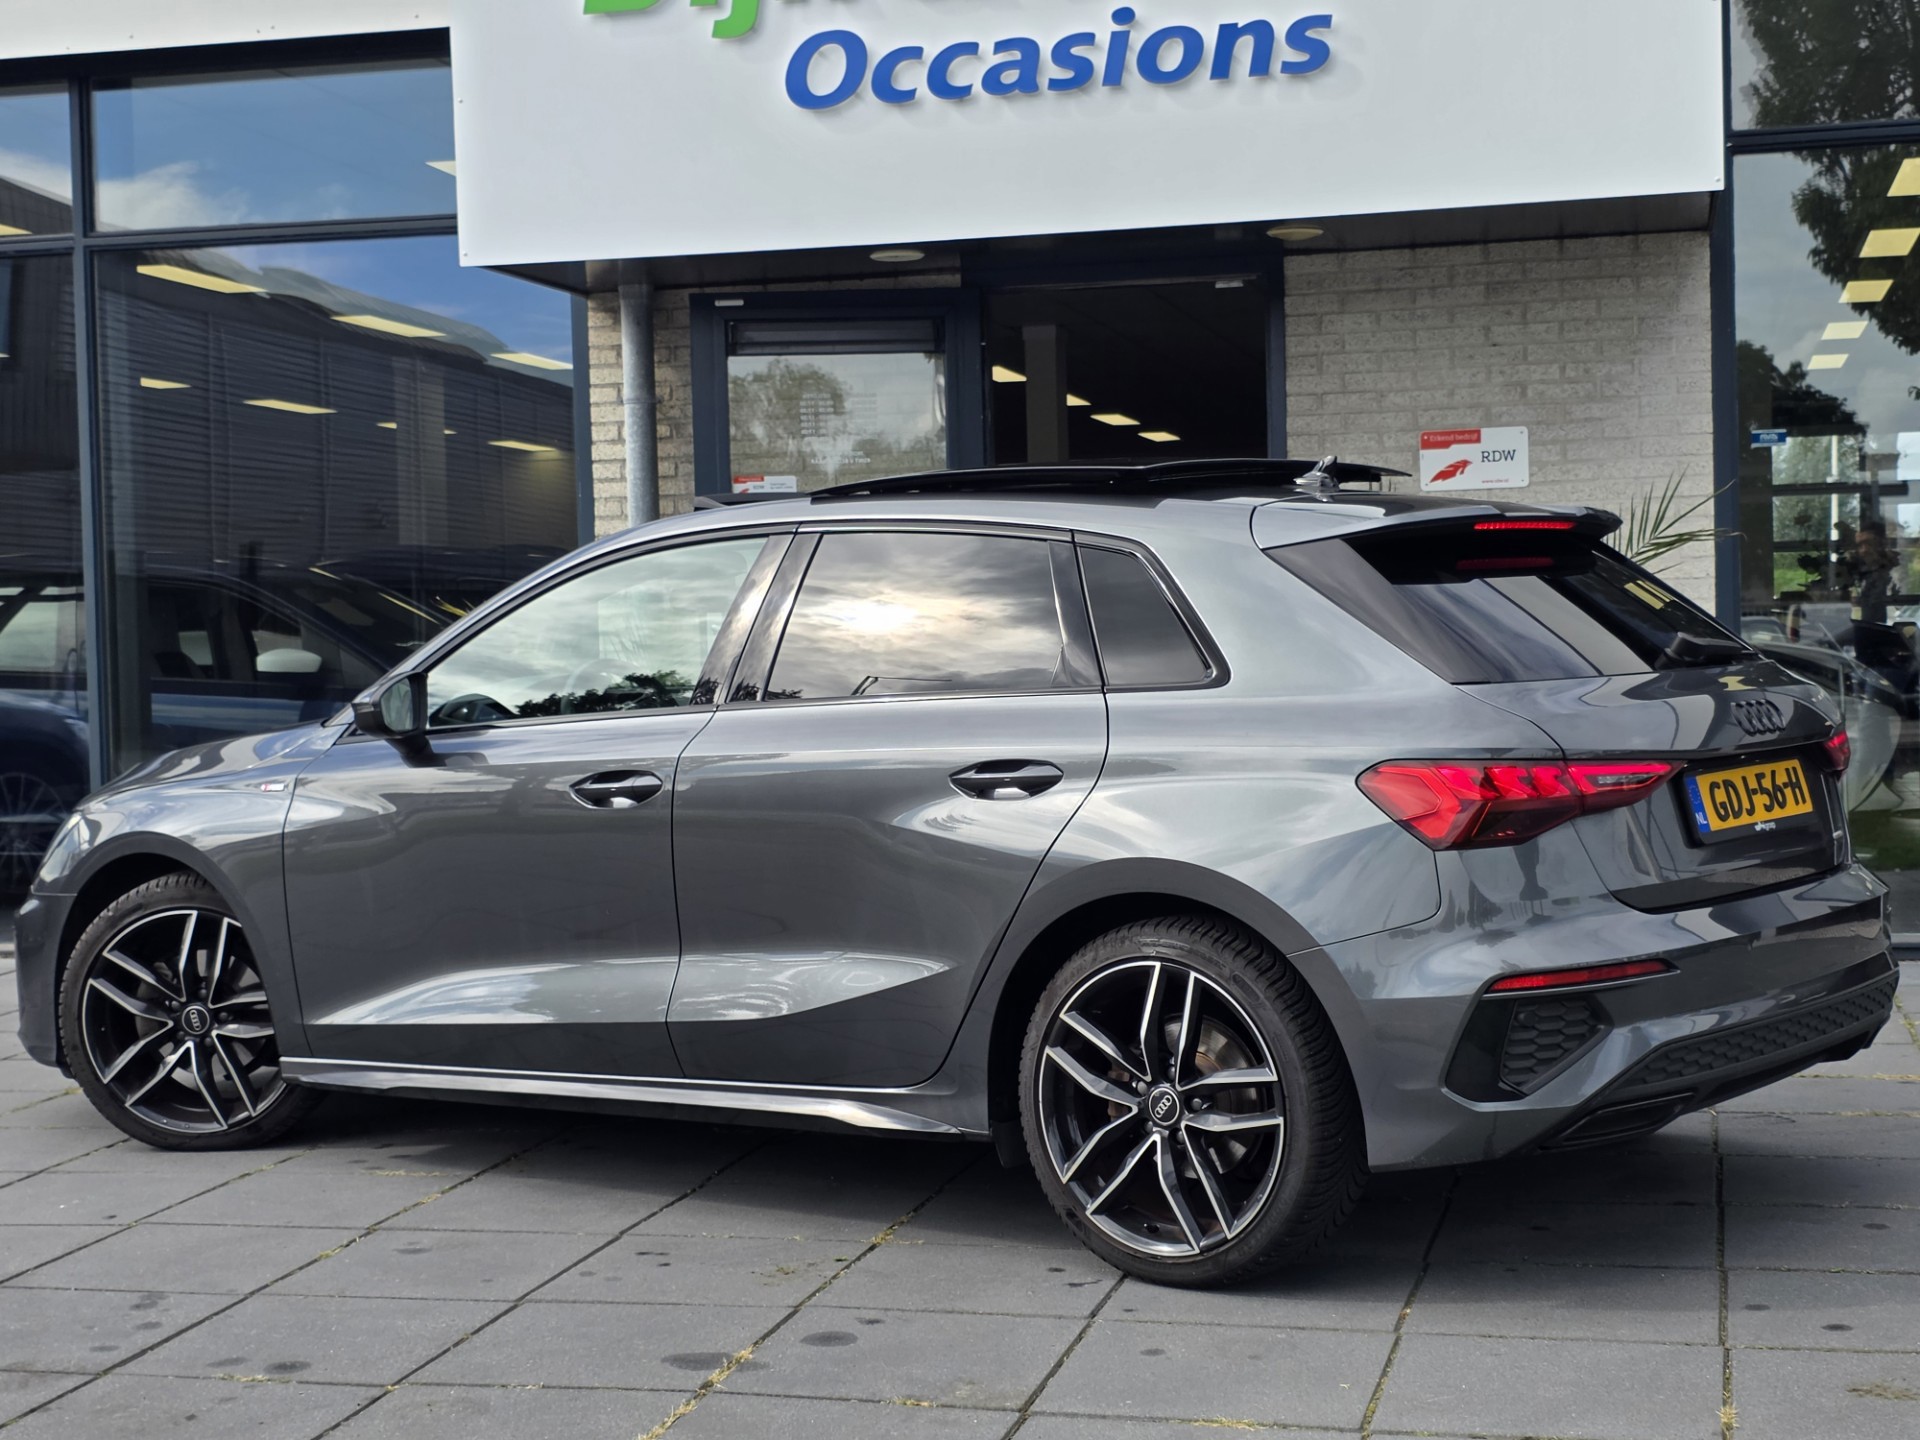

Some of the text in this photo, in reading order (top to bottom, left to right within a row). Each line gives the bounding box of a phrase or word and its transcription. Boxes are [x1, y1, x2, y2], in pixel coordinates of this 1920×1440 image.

[785, 6, 1333, 110] Occasions
[1429, 432, 1478, 442] Erkend bedrijf
[1480, 449, 1516, 463] RDW
[1709, 766, 1807, 822] GDJ-56-H
[1695, 811, 1707, 825] NL
